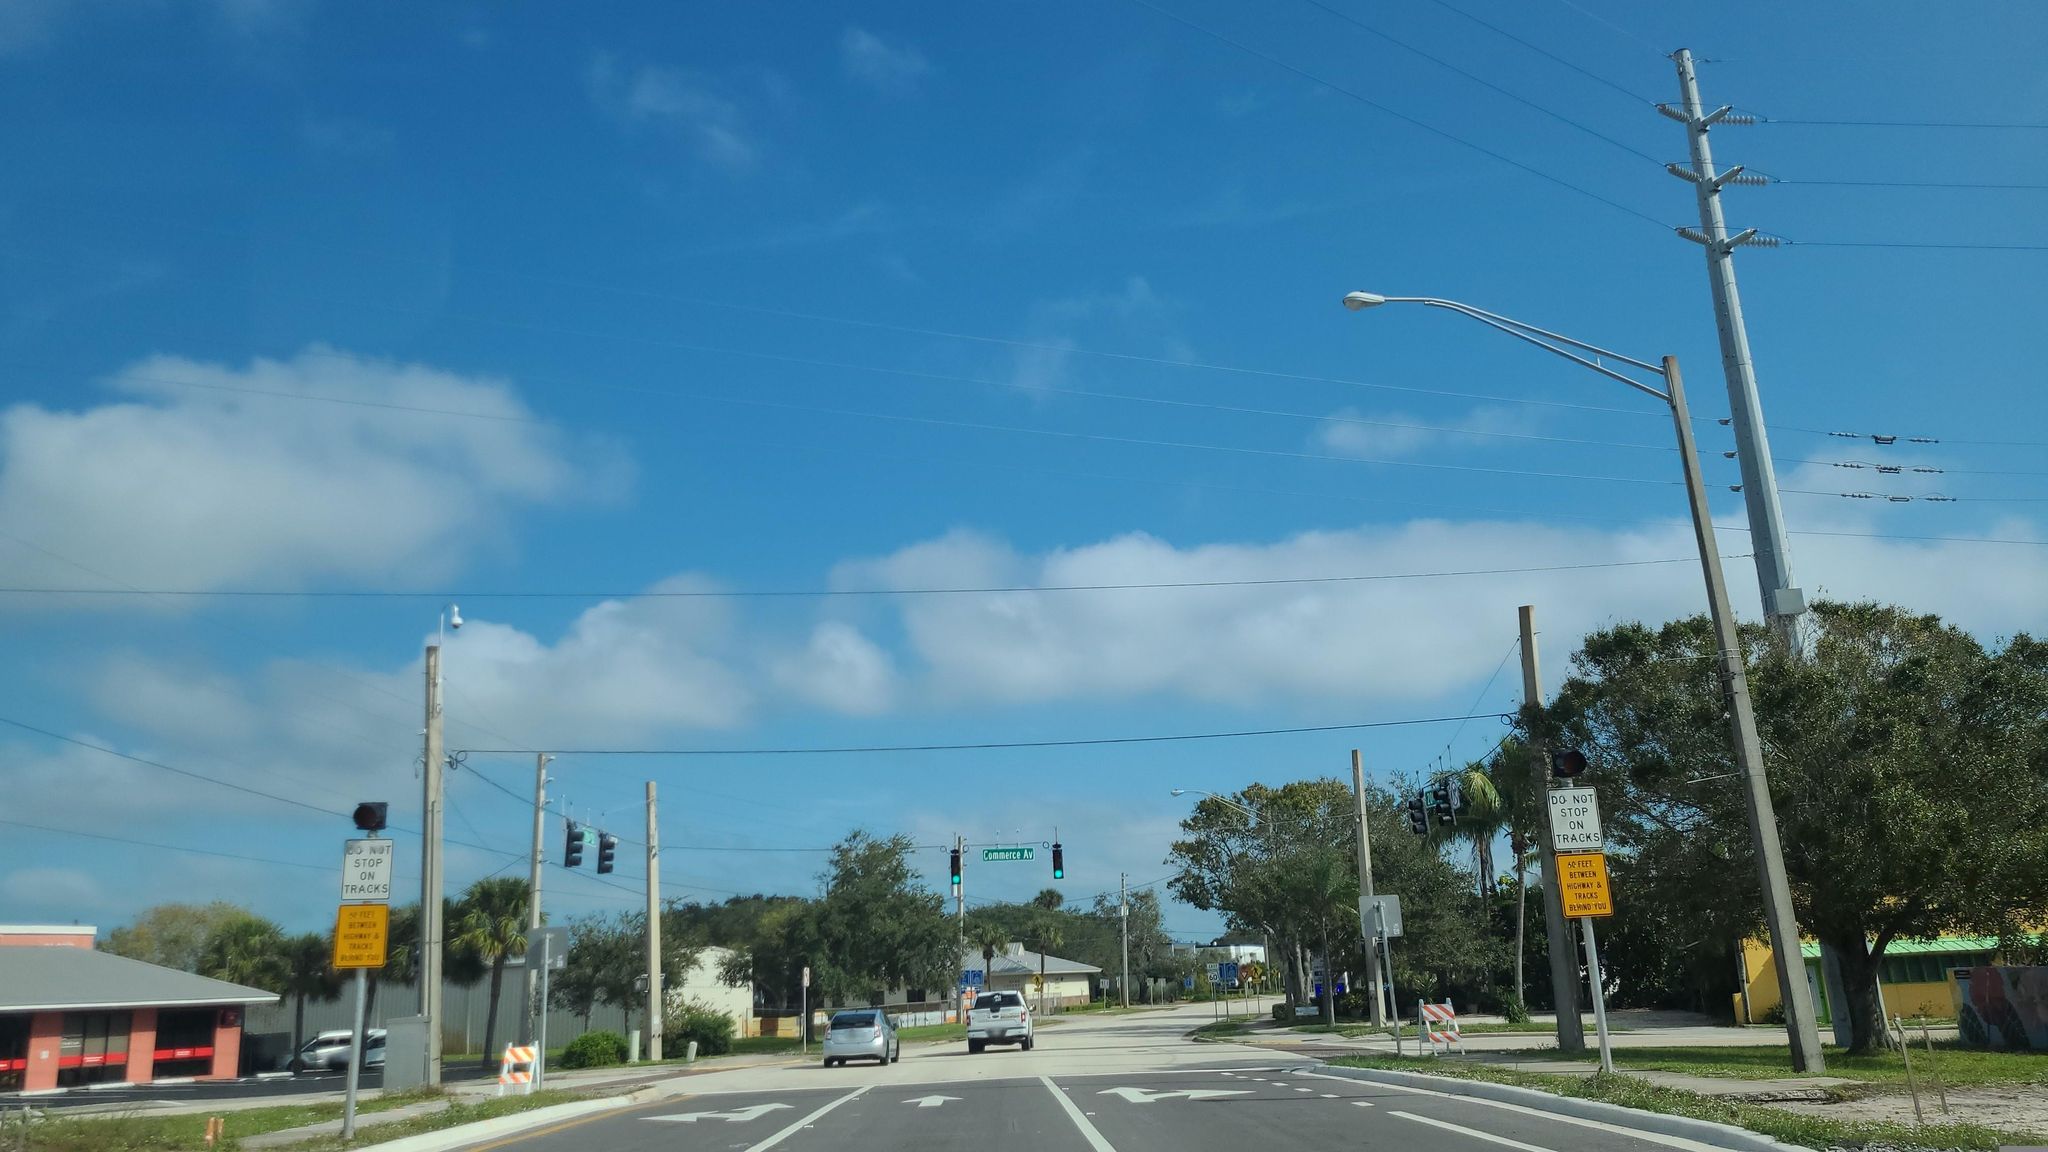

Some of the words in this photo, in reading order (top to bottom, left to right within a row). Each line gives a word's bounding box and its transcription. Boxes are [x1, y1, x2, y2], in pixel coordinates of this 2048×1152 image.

[1551, 796, 1566, 804] DO
[1573, 795, 1594, 804] NOT
[1561, 808, 1588, 817] STOP
[1569, 821, 1584, 830] ON
[1556, 833, 1600, 844] TRACKS
[346, 846, 362, 855] DO
[369, 845, 391, 855] NOT
[984, 851, 1020, 860] Commerce
[1024, 850, 1032, 859] Av
[354, 859, 383, 868] STOP
[1578, 860, 1592, 868] FEET
[360, 872, 375, 881] ON
[1569, 871, 1596, 879] BETWEEN
[345, 884, 388, 894] TRACKS
[1575, 892, 1598, 900] TRACKS
[1569, 903, 1591, 912] BEHIND
[1594, 902, 1607, 910] YOU
